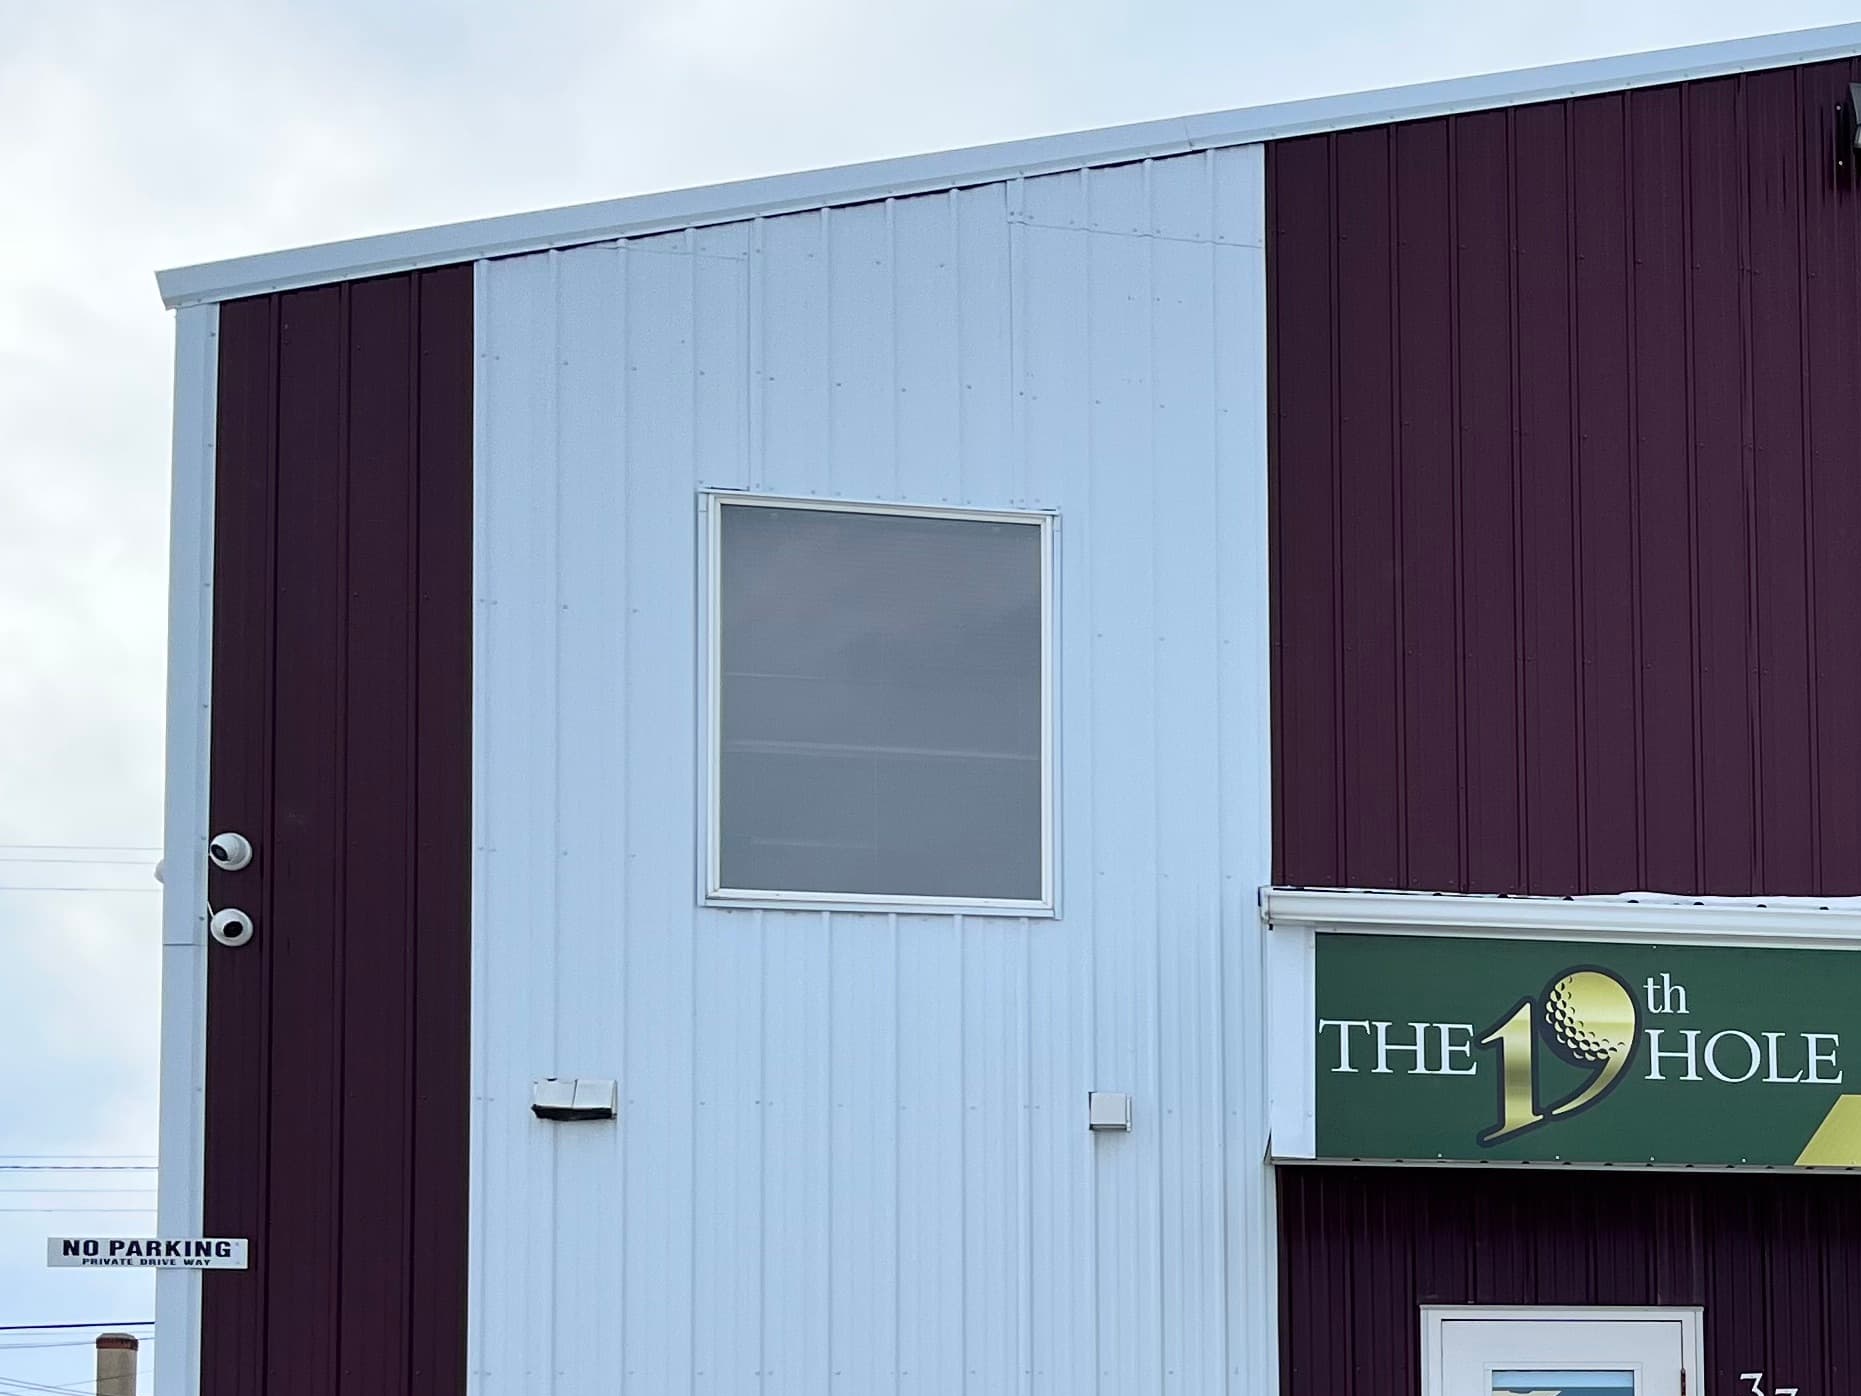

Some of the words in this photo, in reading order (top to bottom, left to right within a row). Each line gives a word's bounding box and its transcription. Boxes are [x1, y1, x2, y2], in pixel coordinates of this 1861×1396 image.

[1319, 1018, 1478, 1076] THE
[1643, 1028, 1844, 1086] HOLE
[62, 1239, 99, 1257] NO
[109, 1239, 232, 1258] PARKING
[82, 1257, 133, 1266] PRIVATE
[139, 1258, 177, 1266] DRIVE
[183, 1258, 212, 1266] WAY
